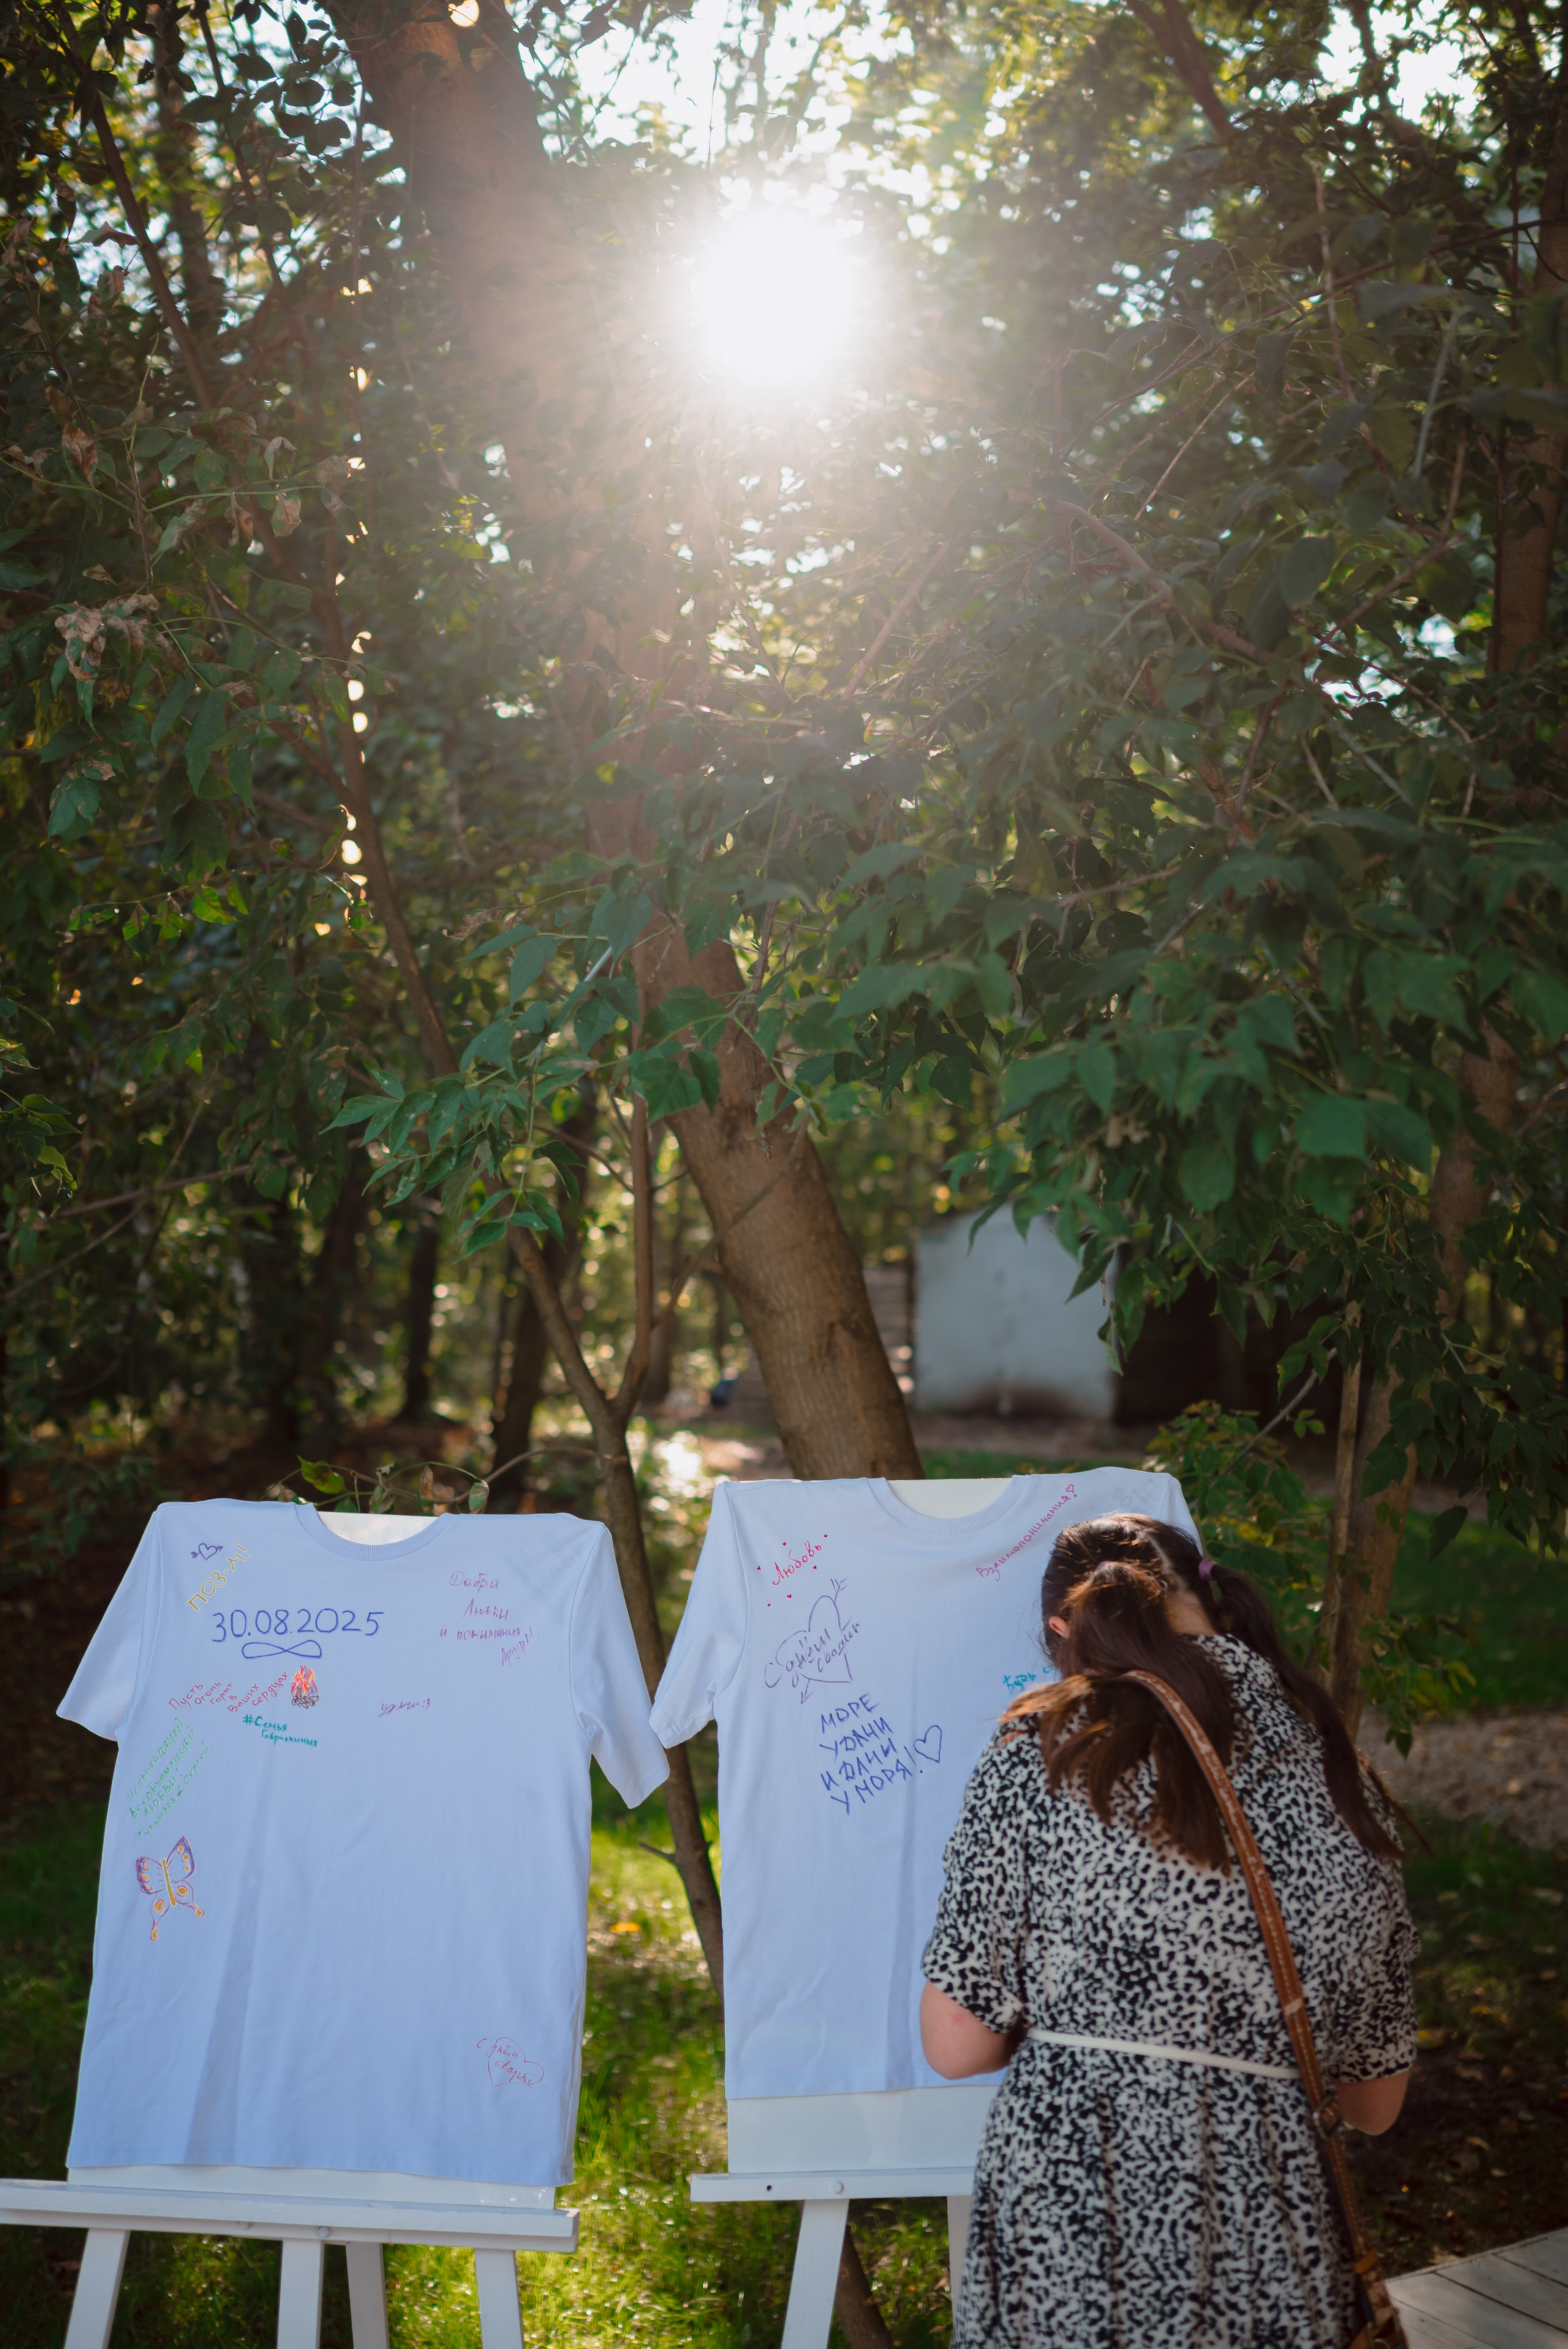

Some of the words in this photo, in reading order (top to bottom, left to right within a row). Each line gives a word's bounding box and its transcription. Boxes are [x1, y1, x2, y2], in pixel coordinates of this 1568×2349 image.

[975, 1495, 1071, 1582] Взаимопонимания
[772, 1540, 822, 1585] Любовь
[212, 1608, 385, 1642] 30.08.2025
[169, 1684, 203, 1711] Пусть
[252, 1672, 288, 1706] сердцах
[821, 1693, 881, 1734] МОРЕ
[243, 1714, 287, 1732] #Семья
[820, 1717, 894, 1763] УДАЧИ
[821, 1771, 840, 1791] И
[839, 1738, 897, 1782] ДАЧИ
[831, 1790, 850, 1815] У
[855, 1746, 923, 1804] МОРЯ!
